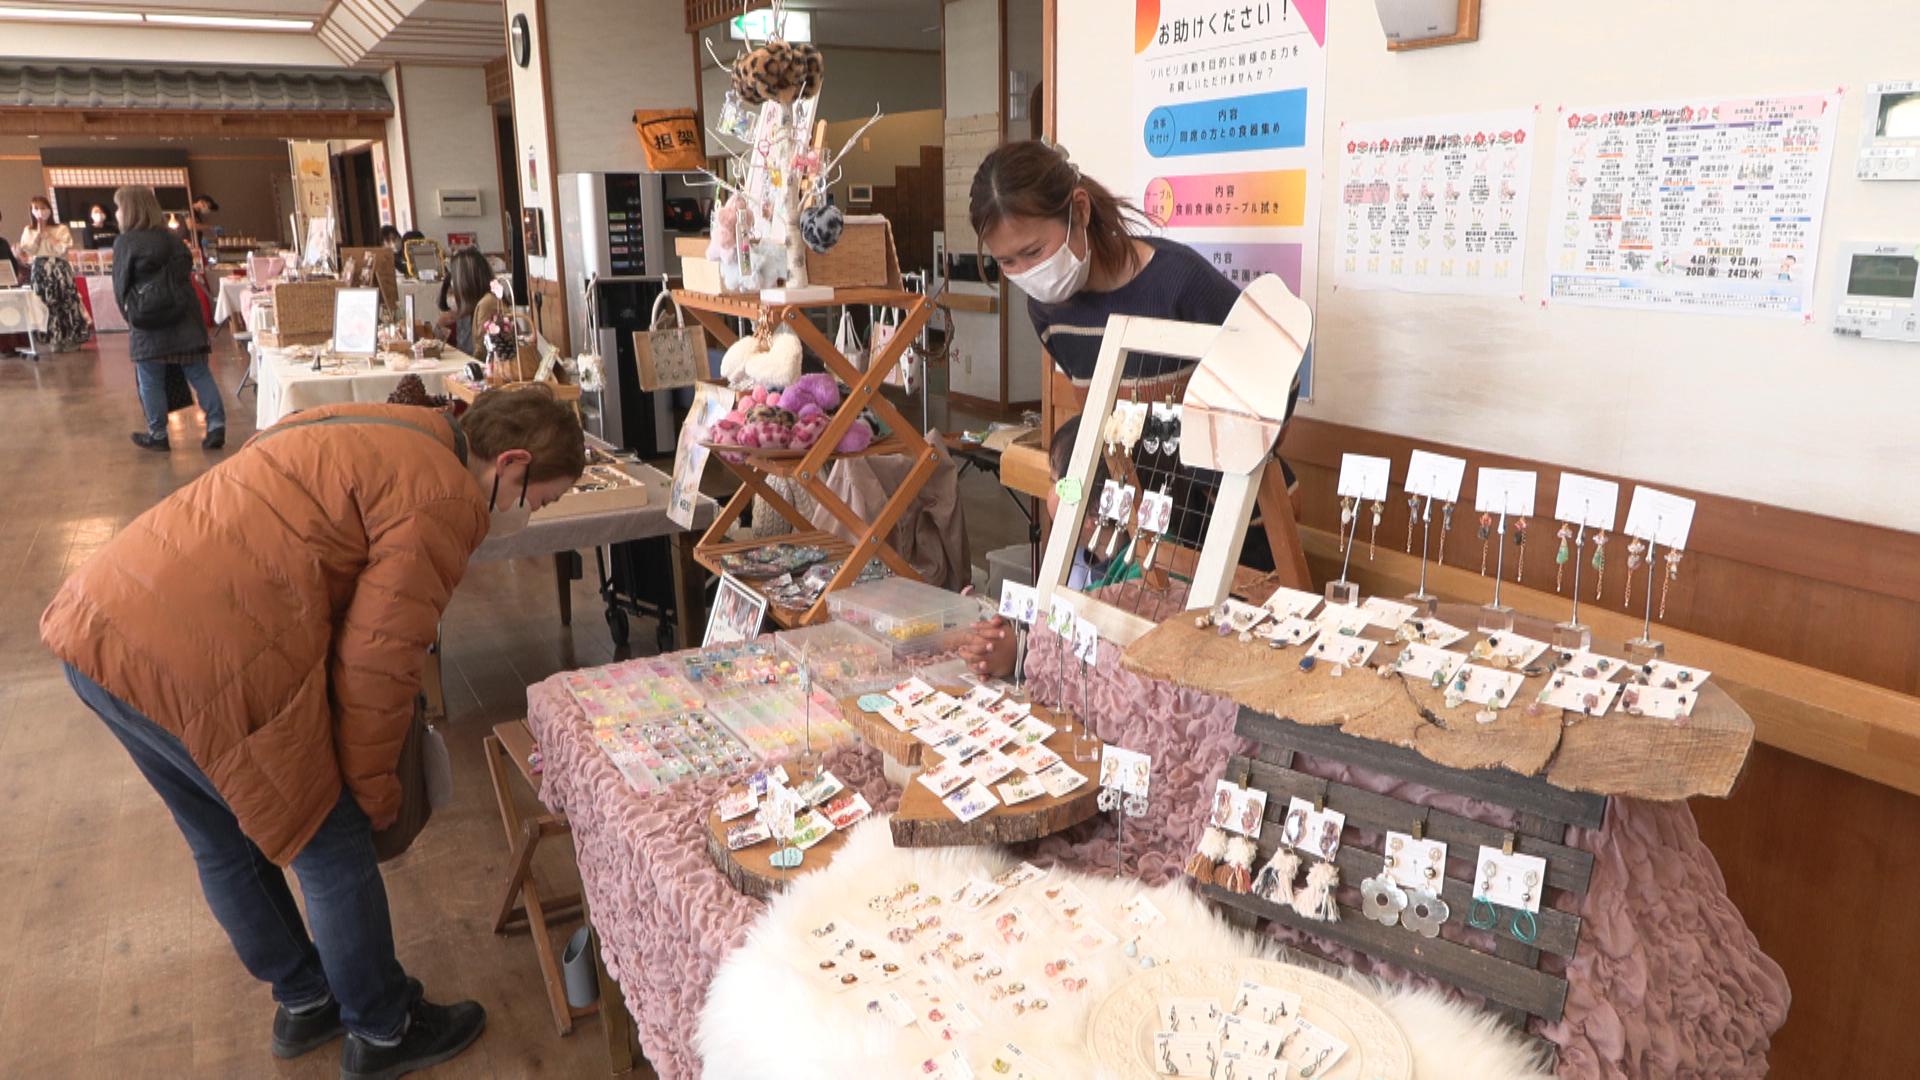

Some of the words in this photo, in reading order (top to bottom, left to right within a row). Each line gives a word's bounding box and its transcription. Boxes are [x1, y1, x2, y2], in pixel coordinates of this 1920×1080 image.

[1158, 0, 1288, 45] お助けください！
[1150, 45, 1300, 79] リハビリ活動を目的に皆様のお力を
[1169, 67, 1273, 93] お貸しいただけませんか？
[1218, 108, 1238, 121] 内容
[654, 128, 697, 150] 担架
[1179, 122, 1281, 143] 同席の方との食器集め
[1215, 185, 1235, 198] 内容
[1175, 201, 1280, 216] 食前食後のテーブル拭き
[1213, 252, 1233, 264] 内容
[1690, 255, 1720, 266] 4日(水)
[1730, 256, 1762, 267] 9日(月)
[1685, 267, 1719, 277] 20日(金)
[1727, 268, 1763, 279] 24日(火)
